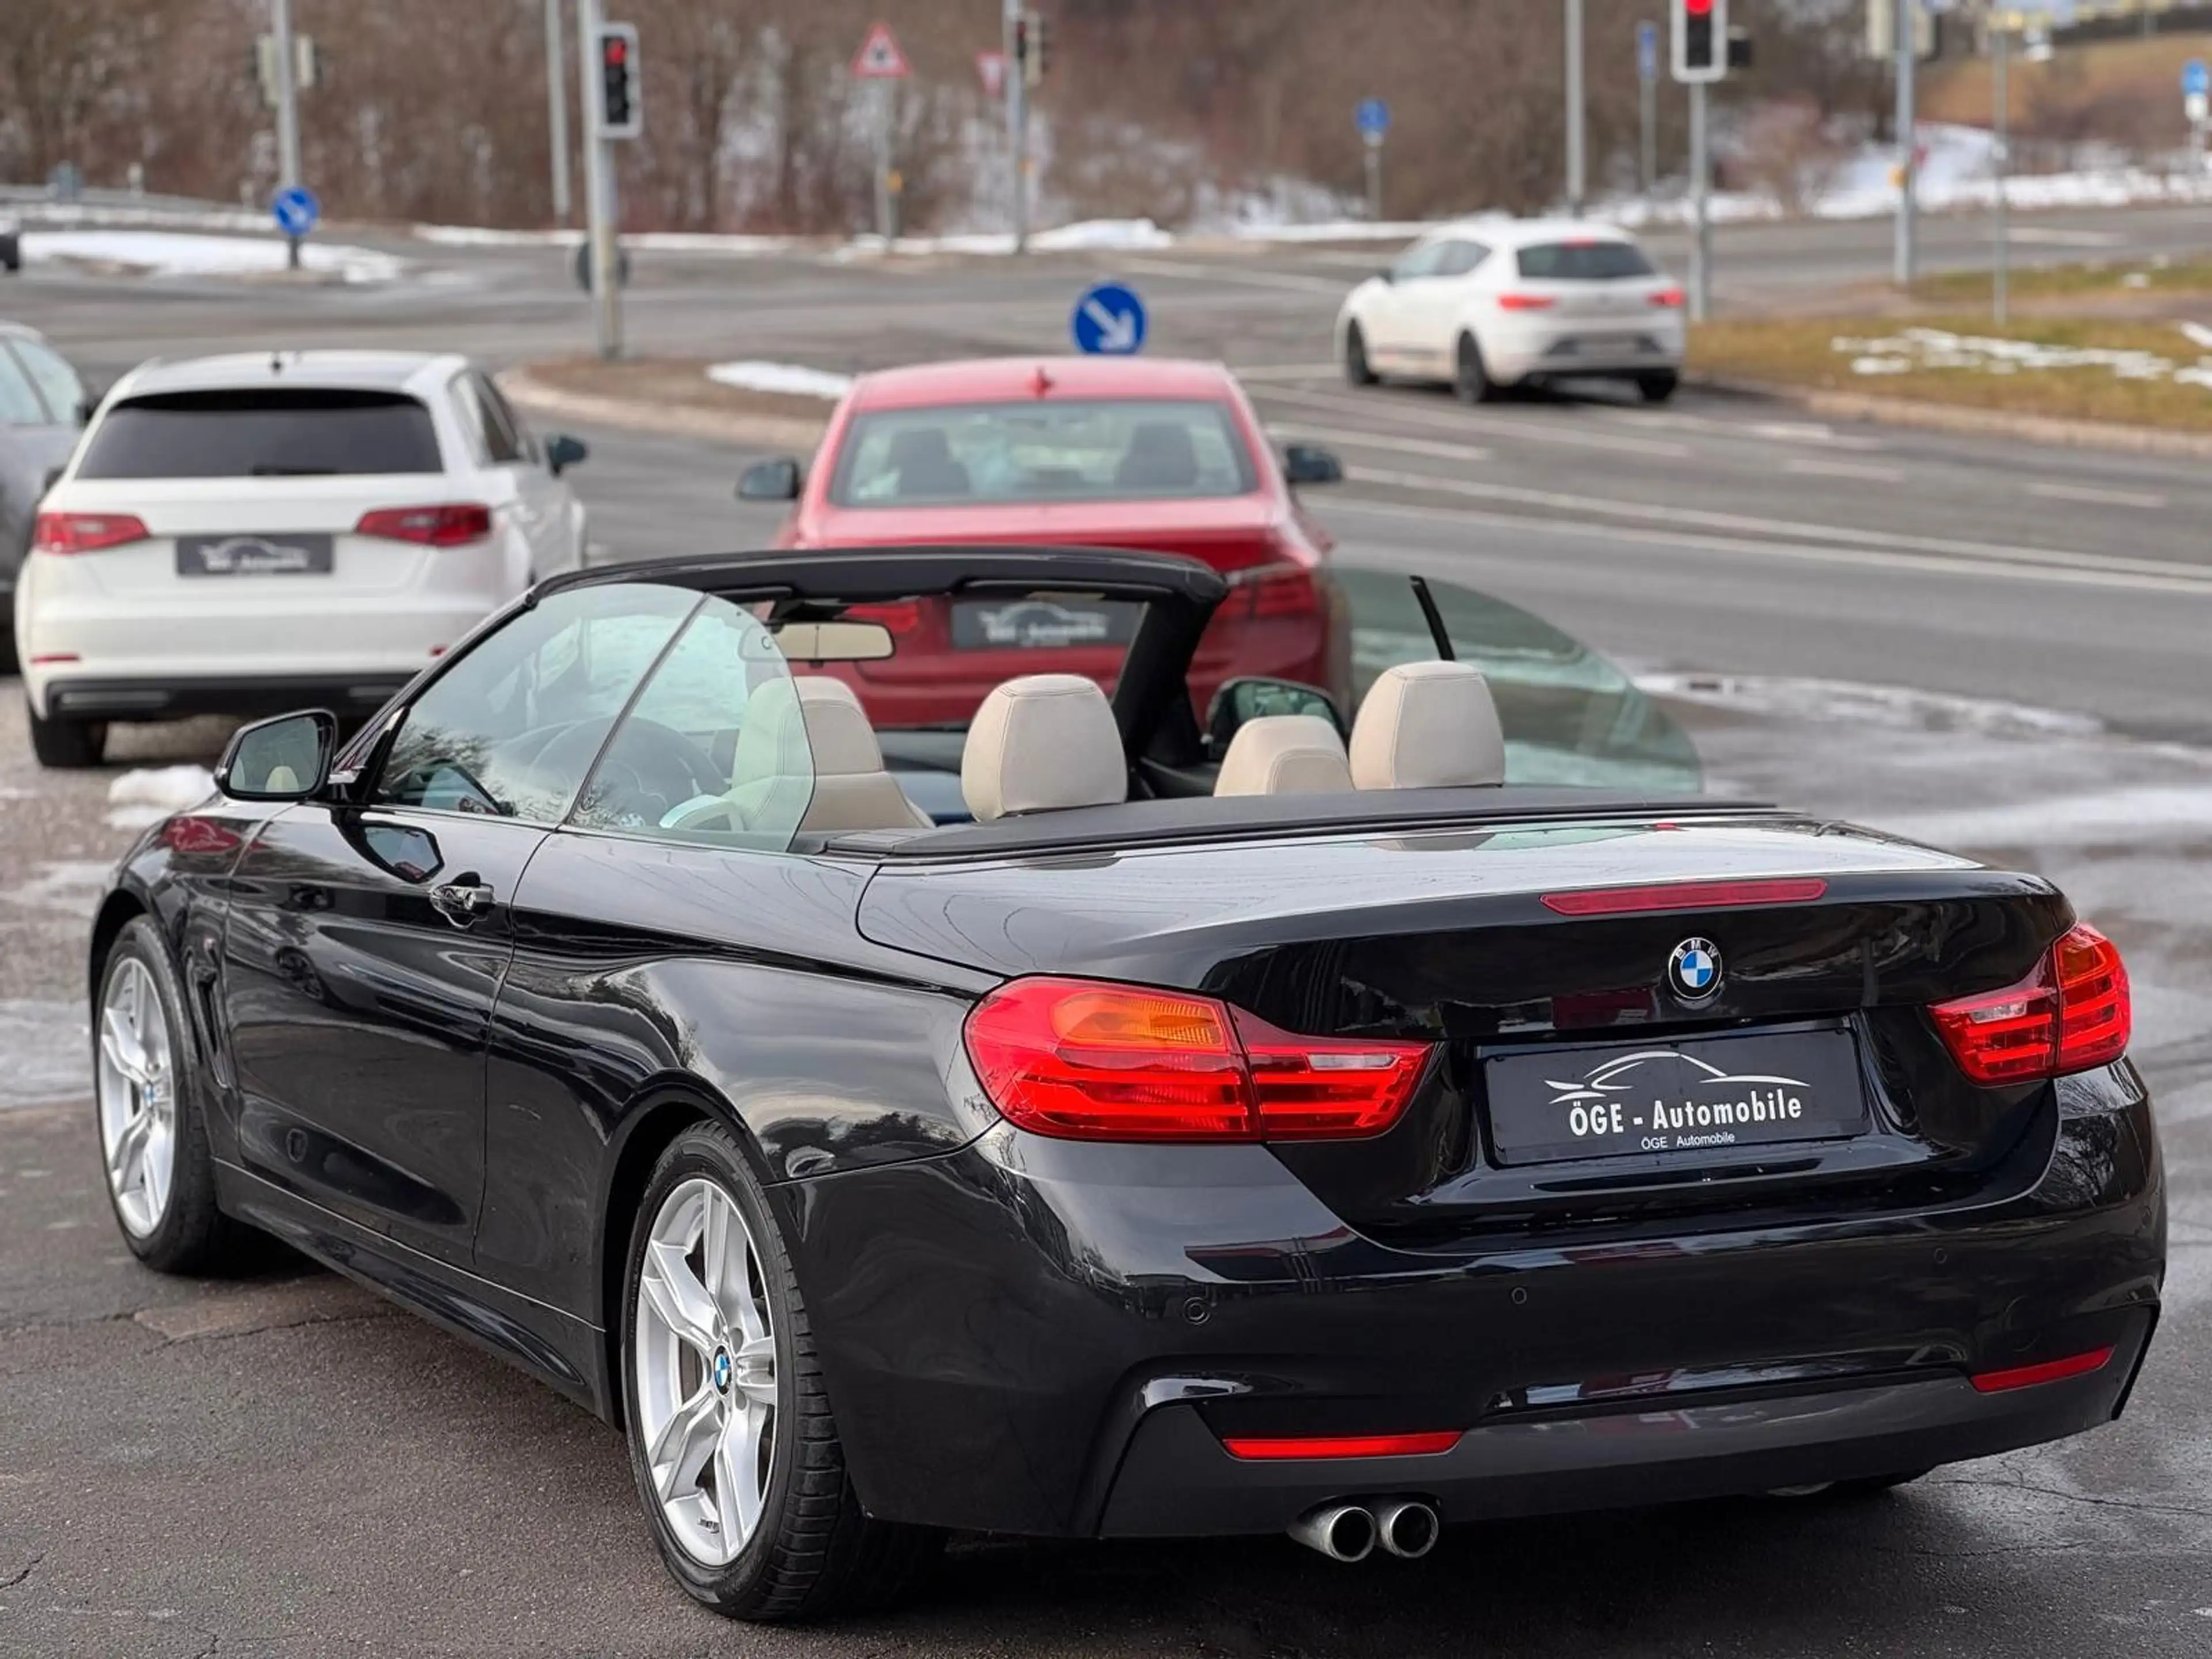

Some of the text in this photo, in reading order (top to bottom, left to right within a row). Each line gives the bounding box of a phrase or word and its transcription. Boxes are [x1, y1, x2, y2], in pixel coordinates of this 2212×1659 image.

[1675, 939, 1719, 960] BMW
[1569, 1101, 1624, 1136] ÖGE
[1653, 1088, 1802, 1130] Automobile
[1641, 1131, 1736, 1150] ÖGE Automobile
